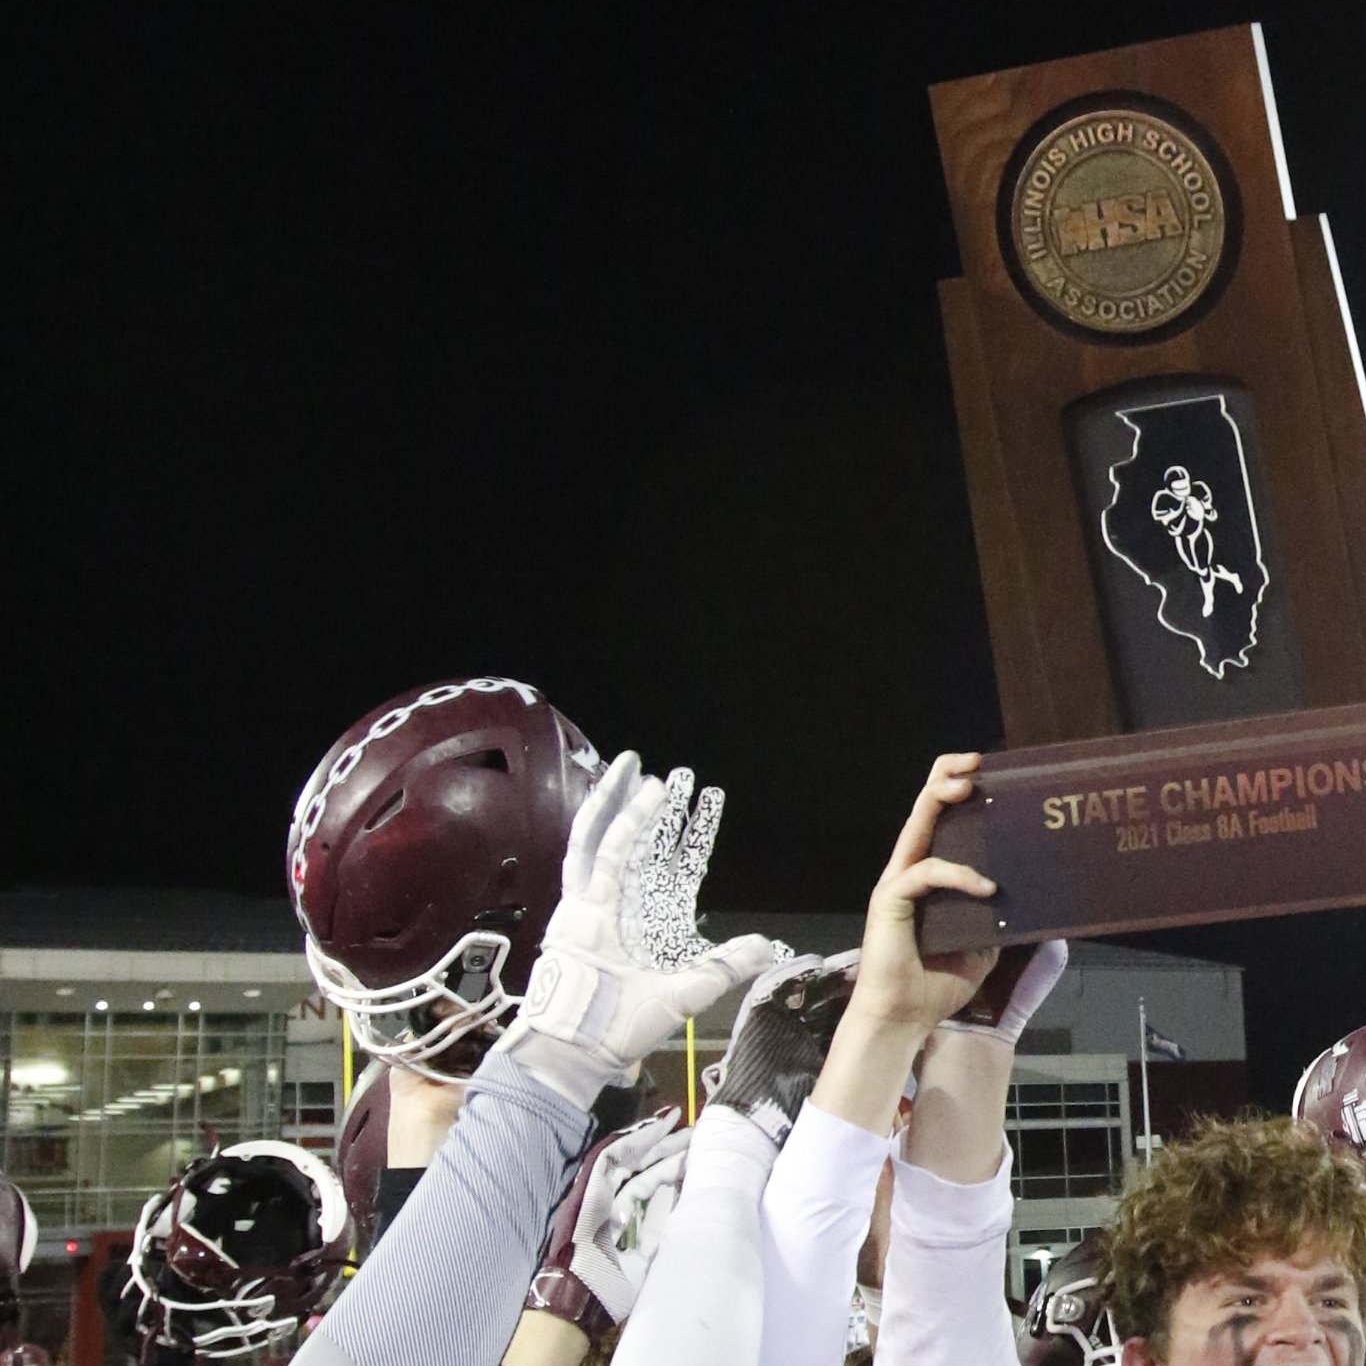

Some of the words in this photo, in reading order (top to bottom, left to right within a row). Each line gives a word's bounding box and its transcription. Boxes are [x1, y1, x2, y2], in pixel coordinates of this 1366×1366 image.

[1024, 147, 1067, 260] ILLINOIS
[1069, 122, 1134, 153] HIGH
[1143, 130, 1212, 228] SCHOOL
[1047, 249, 1208, 321] ASSOCIATION
[1043, 786, 1147, 830] STATE
[1116, 824, 1158, 852] 2021
[1166, 819, 1211, 847] Class
[1216, 813, 1244, 840] 8A
[1250, 803, 1318, 835] Football
